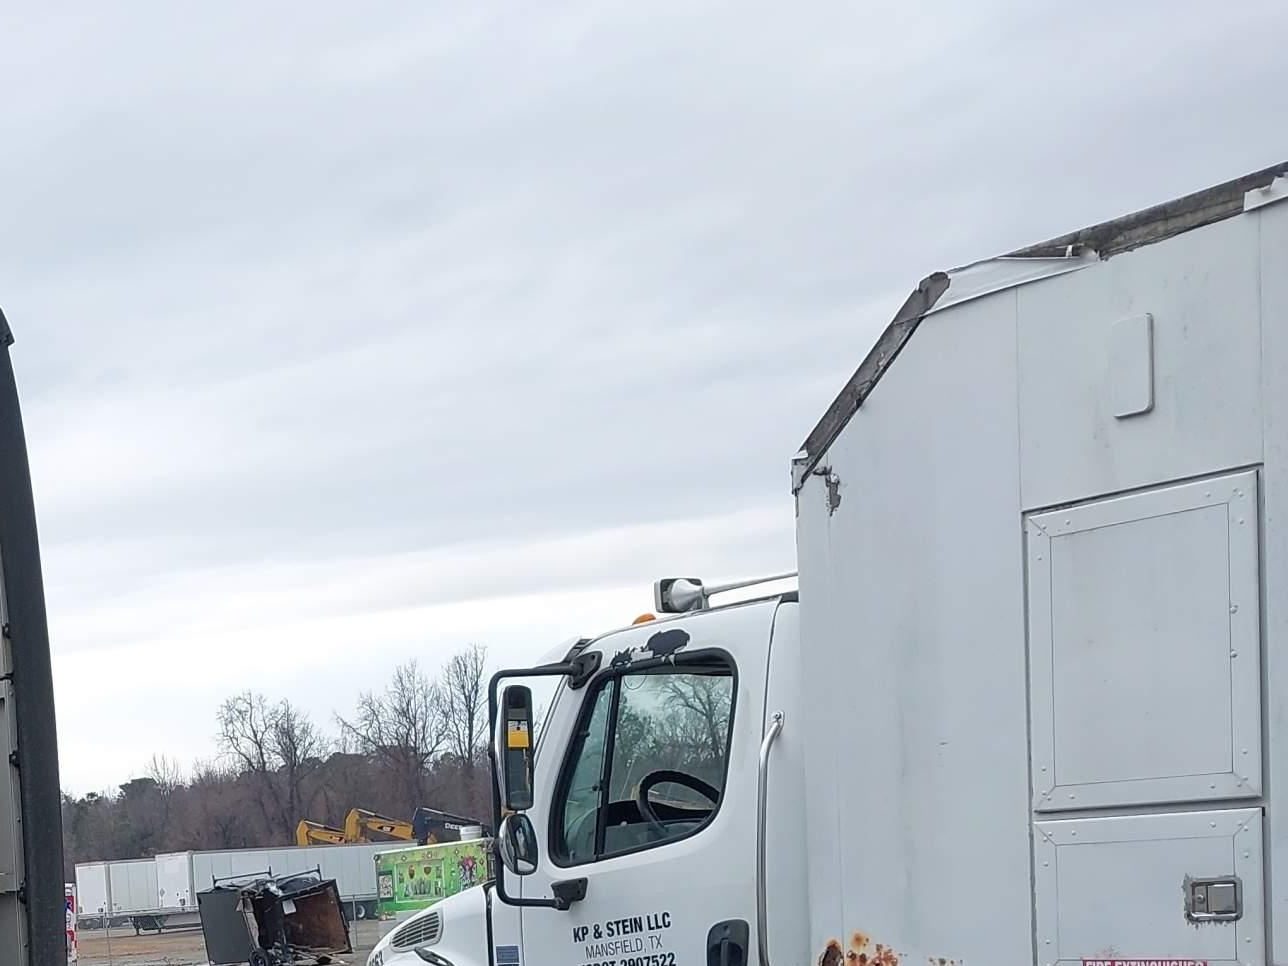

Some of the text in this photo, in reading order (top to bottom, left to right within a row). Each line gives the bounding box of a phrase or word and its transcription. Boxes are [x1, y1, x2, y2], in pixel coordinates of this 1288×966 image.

[572, 911, 671, 943] KP & STEIN LLC
[585, 933, 663, 960] MANSFIELD, TX
